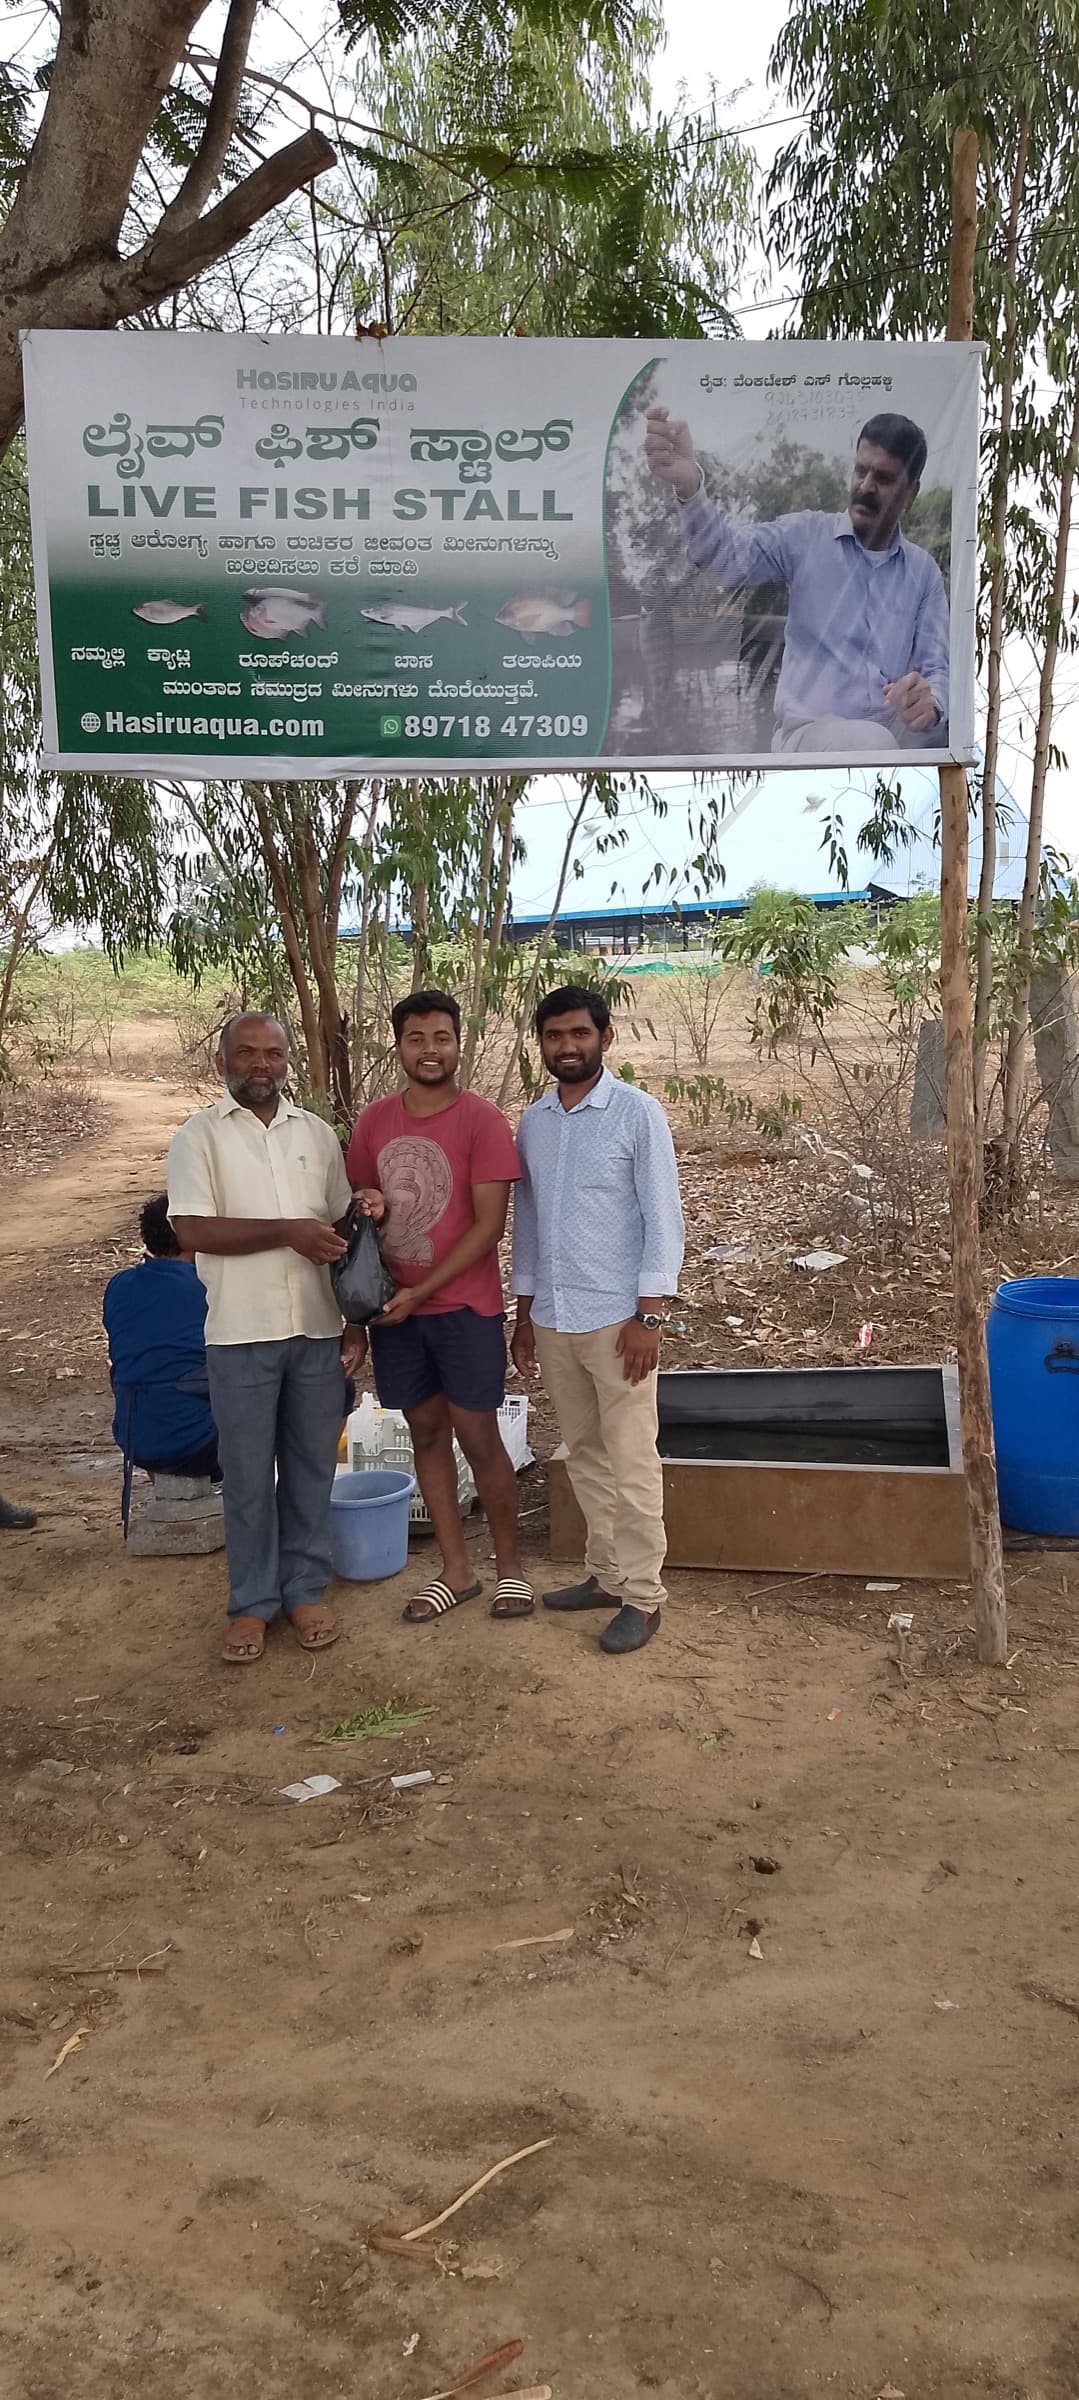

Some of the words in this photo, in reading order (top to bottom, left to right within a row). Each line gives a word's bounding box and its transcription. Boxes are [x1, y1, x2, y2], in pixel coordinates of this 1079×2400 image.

[239, 397, 360, 413] Technologies
[371, 399, 415, 411] India
[83, 412, 225, 480] ಲೈವ್
[255, 417, 380, 469] ಫಿಶ್
[410, 419, 574, 484] ಸ್ಟಾಲ್
[87, 485, 217, 518] LIVE
[239, 487, 370, 520] FISH
[393, 488, 573, 521] STALL
[131, 529, 208, 558] ಆರೋಗ್ಯ
[219, 535, 276, 550] ಹಾಗೂ
[287, 535, 353, 551] ರುಚಿಕರ
[364, 536, 432, 551] ಜೀವಂತ
[443, 536, 559, 560] ಮೀನುಗಳನ್ನು
[329, 555, 360, 575] ಕರೆ
[369, 560, 418, 575] ಮಾಡಿ
[394, 655, 433, 669] ಬಾಸ
[502, 654, 582, 669] ತಲಾಪಿಯ
[163, 681, 241, 696] ಮುಂತಾದ
[250, 681, 322, 702] ಸಮುದ್ರದ
[331, 682, 419, 698] ಮೀನುಗಳು
[105, 711, 325, 740] Hasiruaqua.com
[404, 715, 490, 738] 89718
[500, 715, 588, 738] 47309
